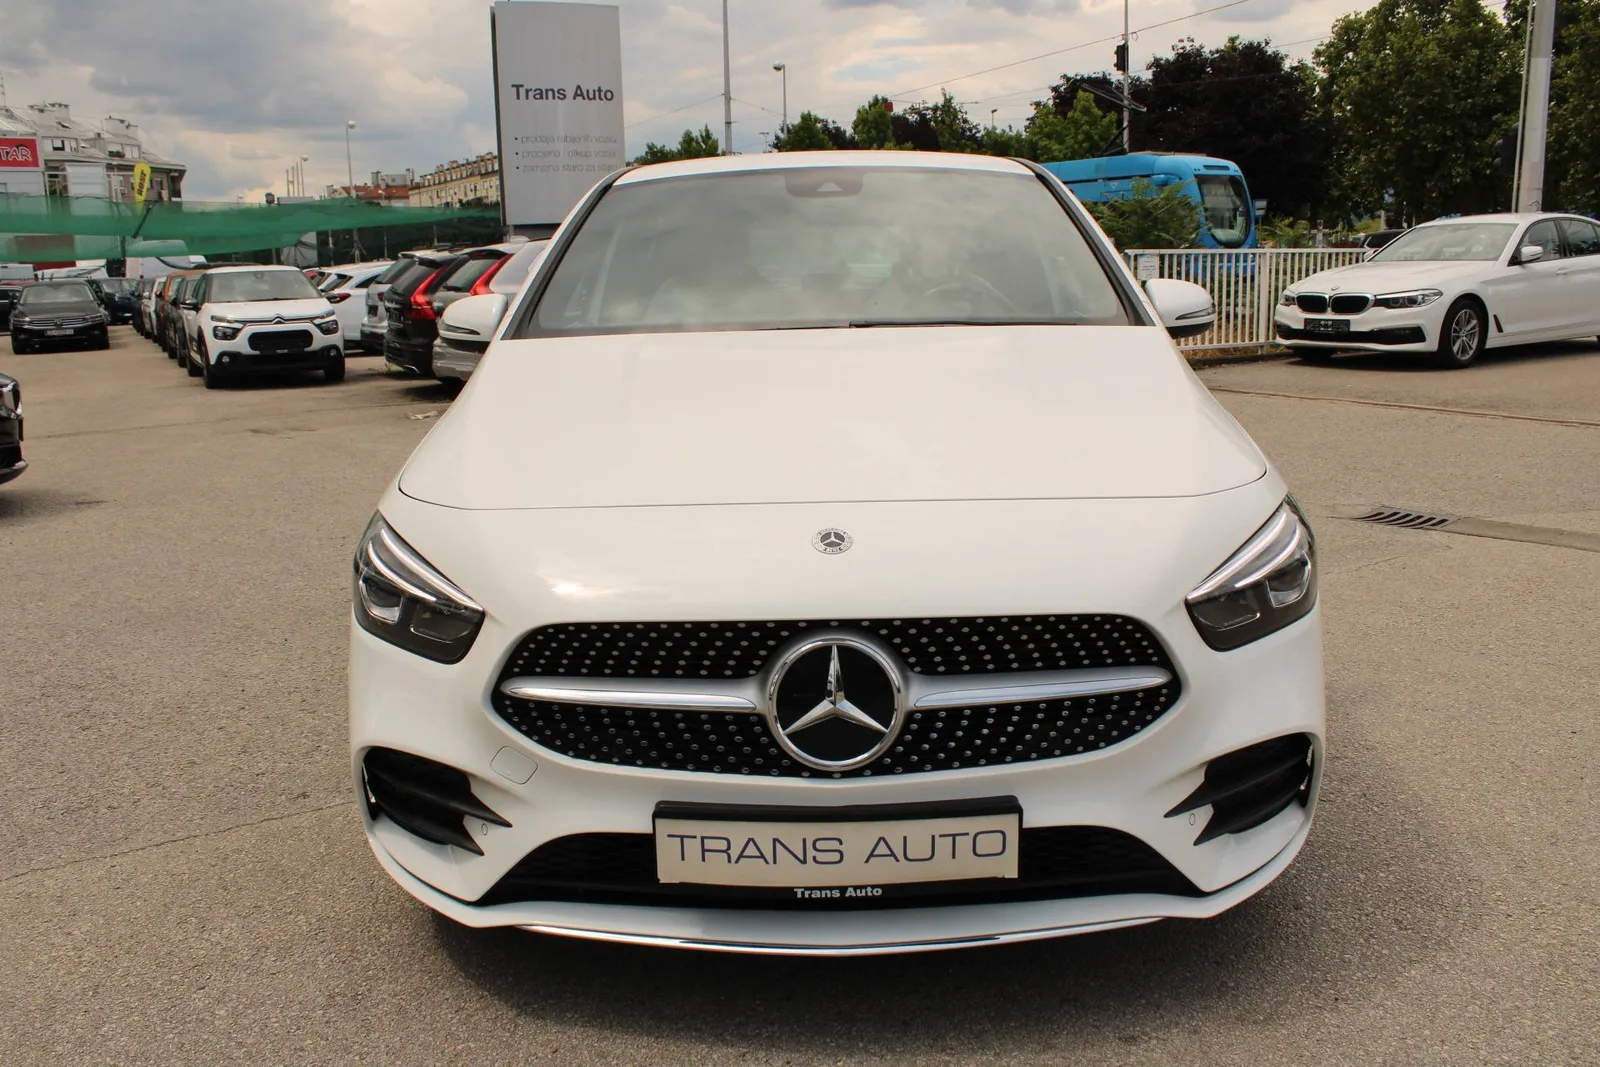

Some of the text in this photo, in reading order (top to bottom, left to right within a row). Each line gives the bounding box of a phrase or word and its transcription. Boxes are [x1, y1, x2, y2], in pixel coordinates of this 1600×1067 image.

[511, 84, 614, 102] Trans Auto
[667, 829, 1007, 865] TRANS AUTO
[794, 886, 882, 899] Trans Auto
